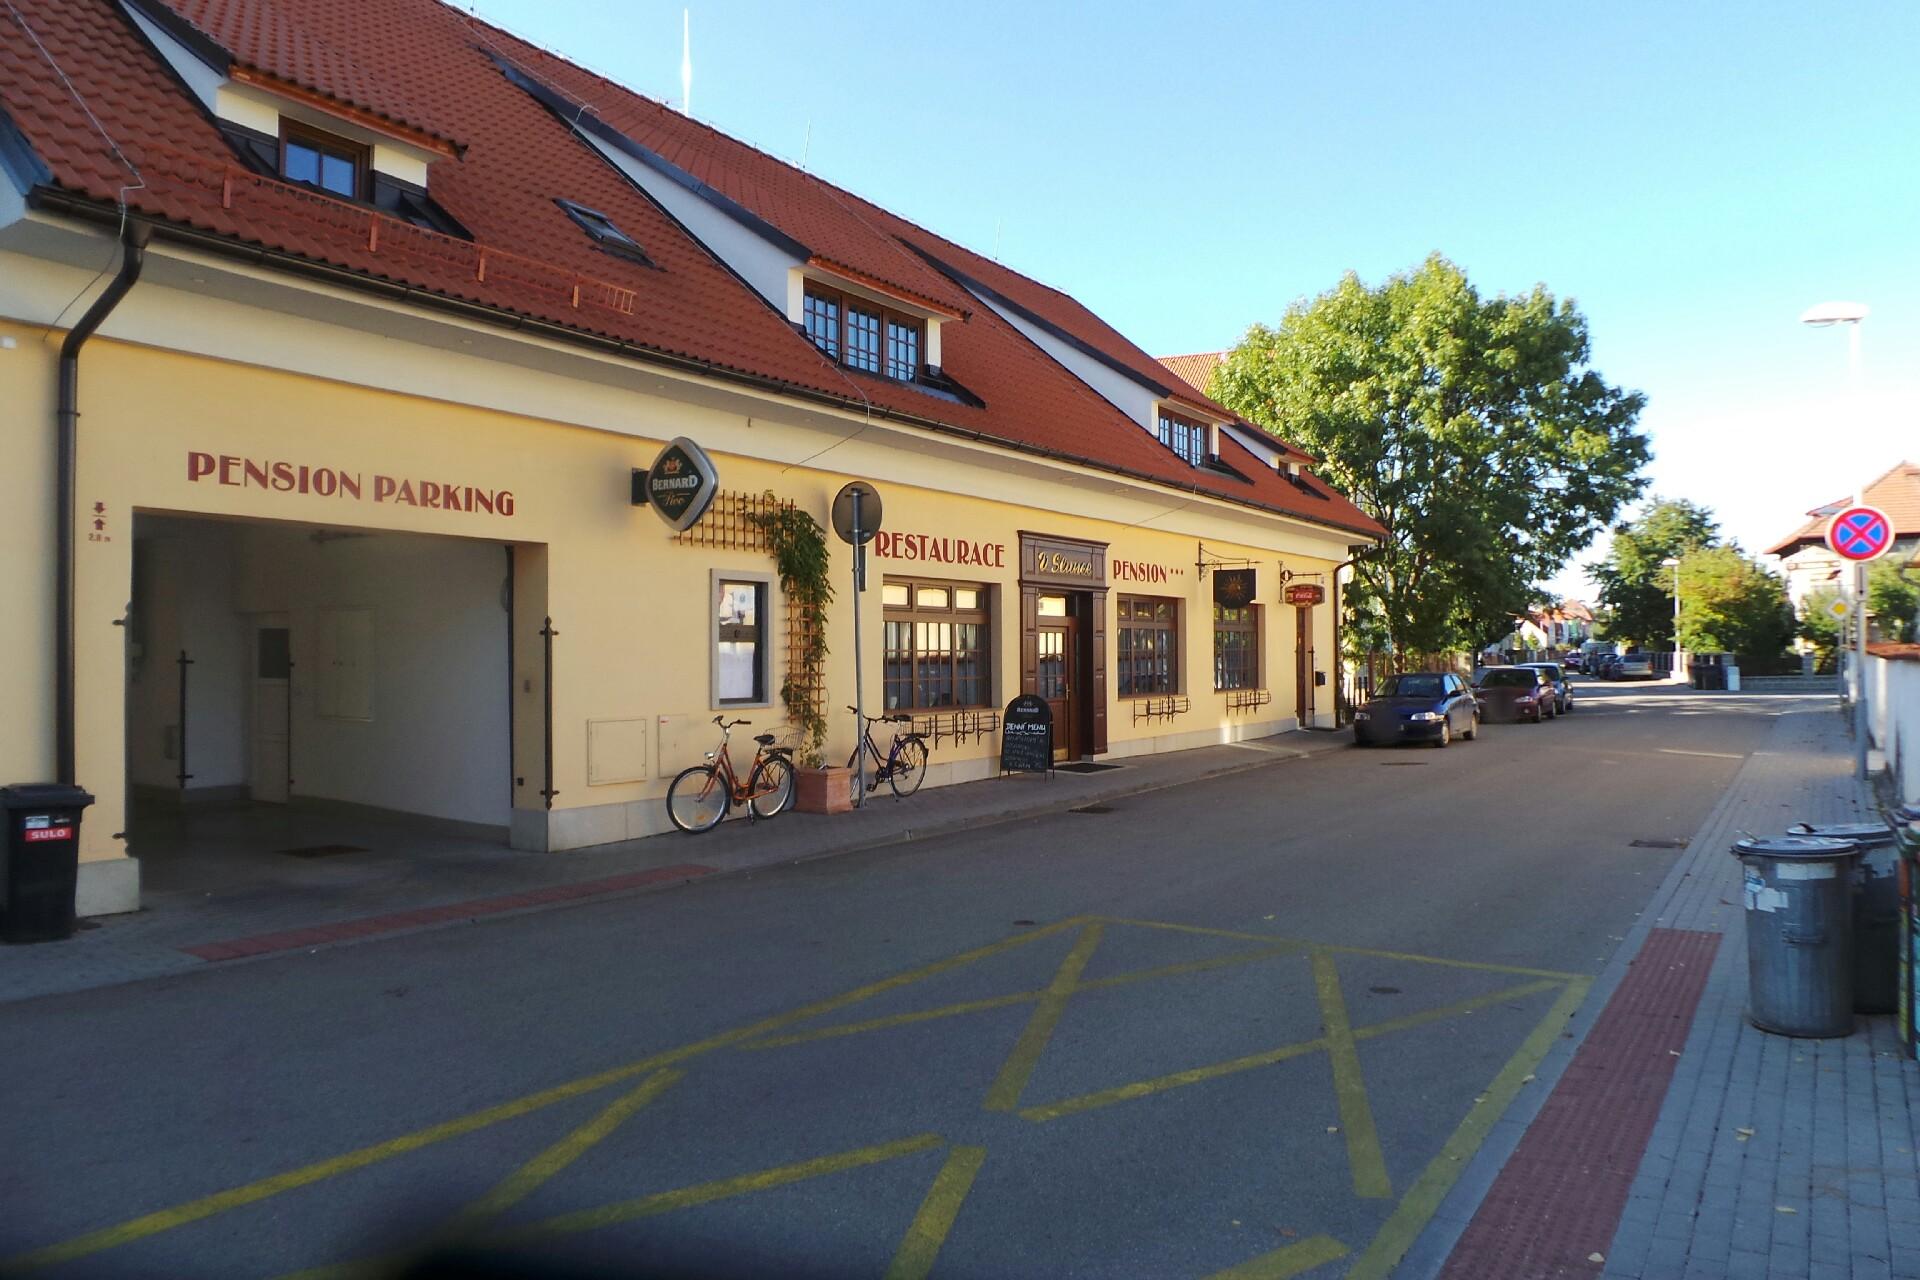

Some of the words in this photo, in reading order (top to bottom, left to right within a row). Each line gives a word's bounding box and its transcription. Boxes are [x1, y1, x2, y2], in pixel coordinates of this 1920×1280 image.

[187, 451, 361, 501] PENSION
[373, 474, 515, 517] PARKING
[652, 474, 698, 491] BERNARD
[875, 530, 1005, 568] RESTAURACE
[1113, 559, 1167, 584] PENSION
[31, 829, 66, 839] SULO
